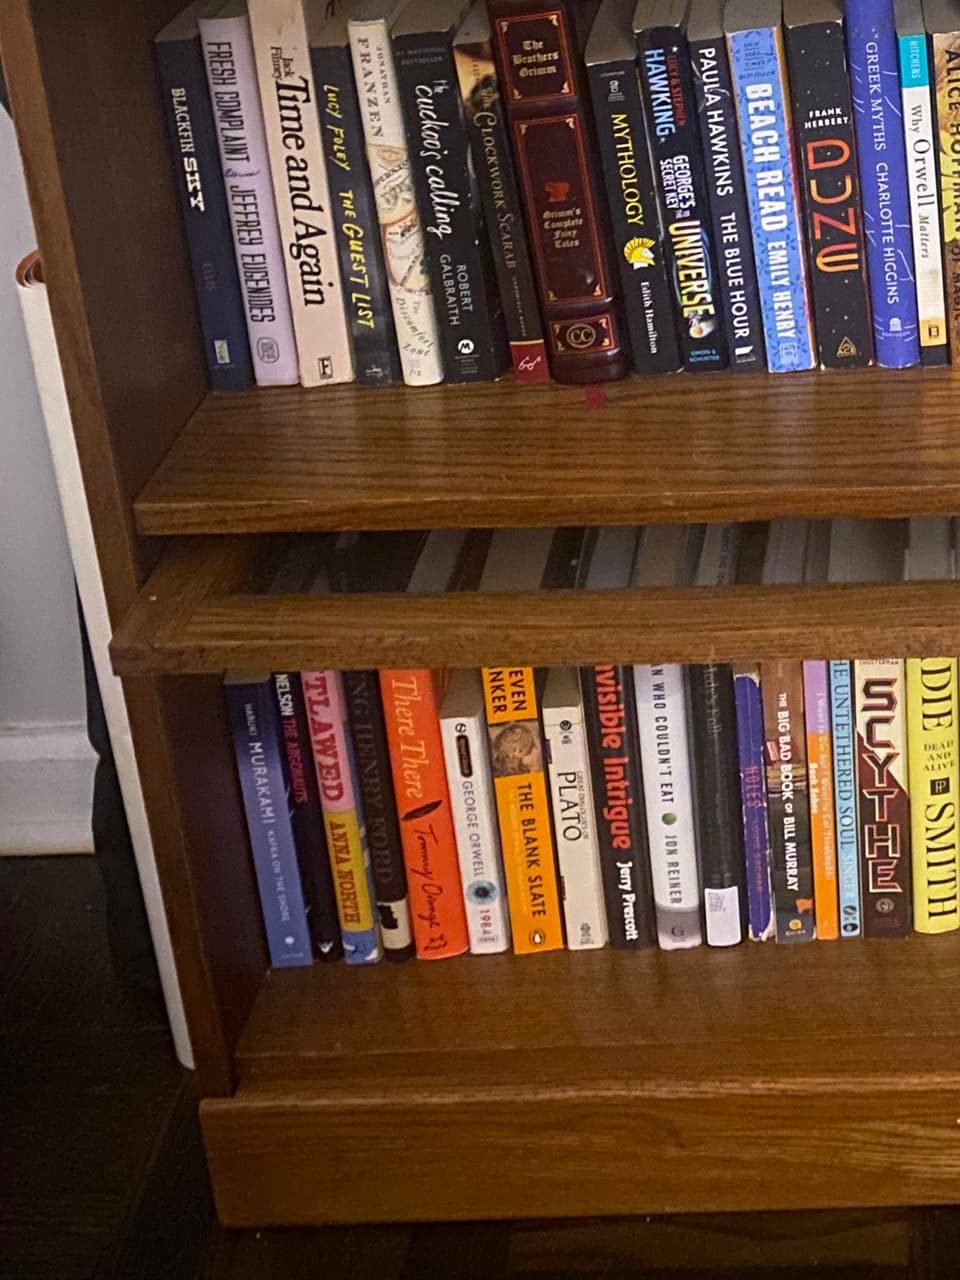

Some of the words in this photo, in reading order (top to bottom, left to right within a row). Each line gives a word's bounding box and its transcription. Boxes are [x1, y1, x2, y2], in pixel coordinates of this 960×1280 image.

[207, 42, 237, 86] FRESH
[270, 46, 283, 80] Finney
[281, 57, 295, 78] Jack
[699, 48, 721, 105] PAULA
[865, 42, 882, 94] GREEK
[910, 41, 921, 79] HITCHENS
[215, 91, 250, 161] COMPLAINT
[274, 75, 310, 149] Time
[745, 84, 779, 162] BEACH
[805, 120, 849, 129] HERBERT
[871, 98, 887, 151] MYTHS
[171, 88, 195, 152] BLACKFIN
[183, 157, 204, 211] SKY
[706, 110, 733, 196] HAWKINS
[285, 155, 324, 212] and
[755, 171, 787, 231] READ
[875, 162, 895, 244] CHARLOTTE
[230, 185, 264, 246] JEFFREY
[719, 213, 737, 243] THE
[241, 254, 276, 322] EUGENIDES
[290, 221, 333, 306] Again
[440, 254, 459, 325] GALBRAITH
[456, 265, 473, 311] ROBERT
[724, 248, 744, 286] BLUE
[766, 241, 789, 284] EMILY
[883, 247, 899, 304] HIGGINS
[730, 291, 750, 338] HOUR
[774, 291, 796, 338] HENRY
[391, 678, 419, 735] There
[399, 742, 425, 799] There
[518, 784, 533, 810] THE
[557, 772, 582, 841] PLATO
[523, 819, 540, 868] BLANK
[926, 804, 957, 919] SMITH
[528, 876, 545, 917] SLATE
